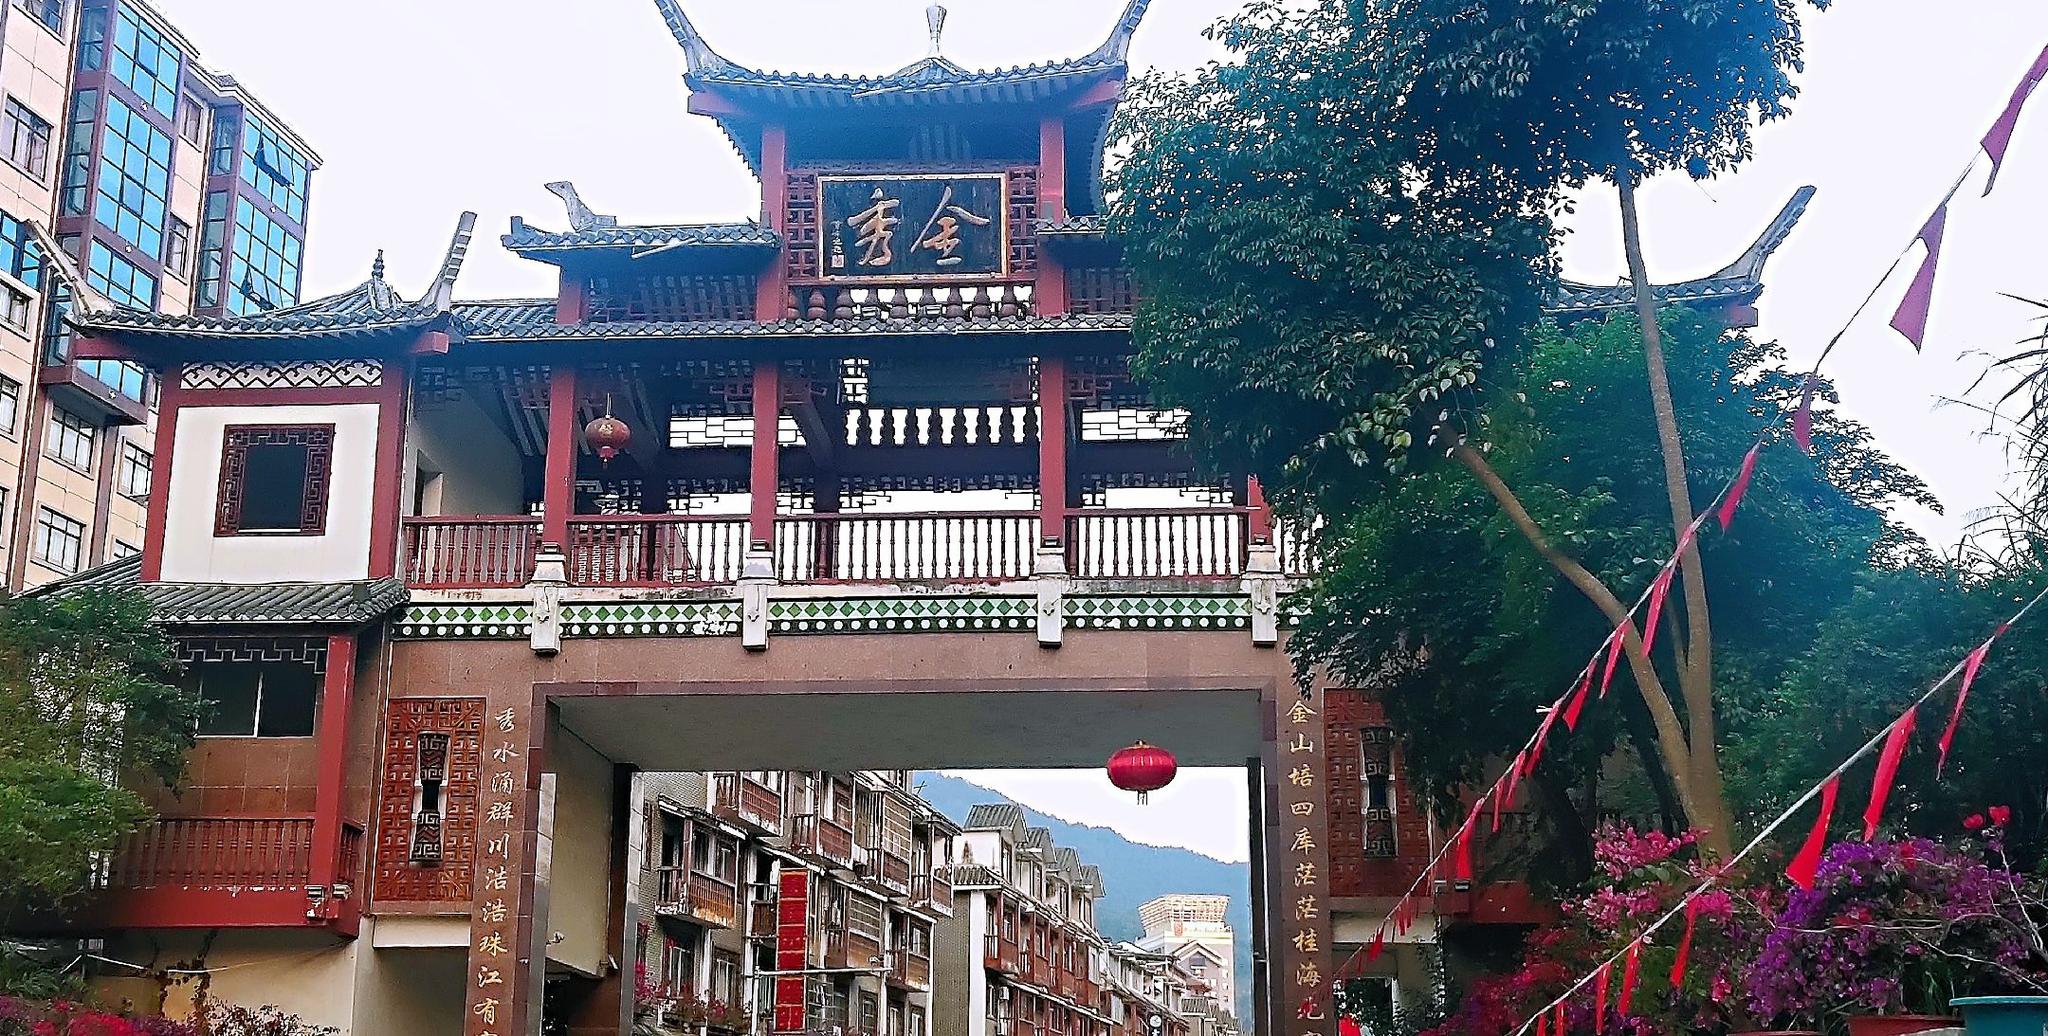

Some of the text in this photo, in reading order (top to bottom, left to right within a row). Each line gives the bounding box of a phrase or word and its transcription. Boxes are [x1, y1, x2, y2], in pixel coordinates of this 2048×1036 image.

[473, 706, 520, 1036] 秀水涌群川浩浩珠江有
